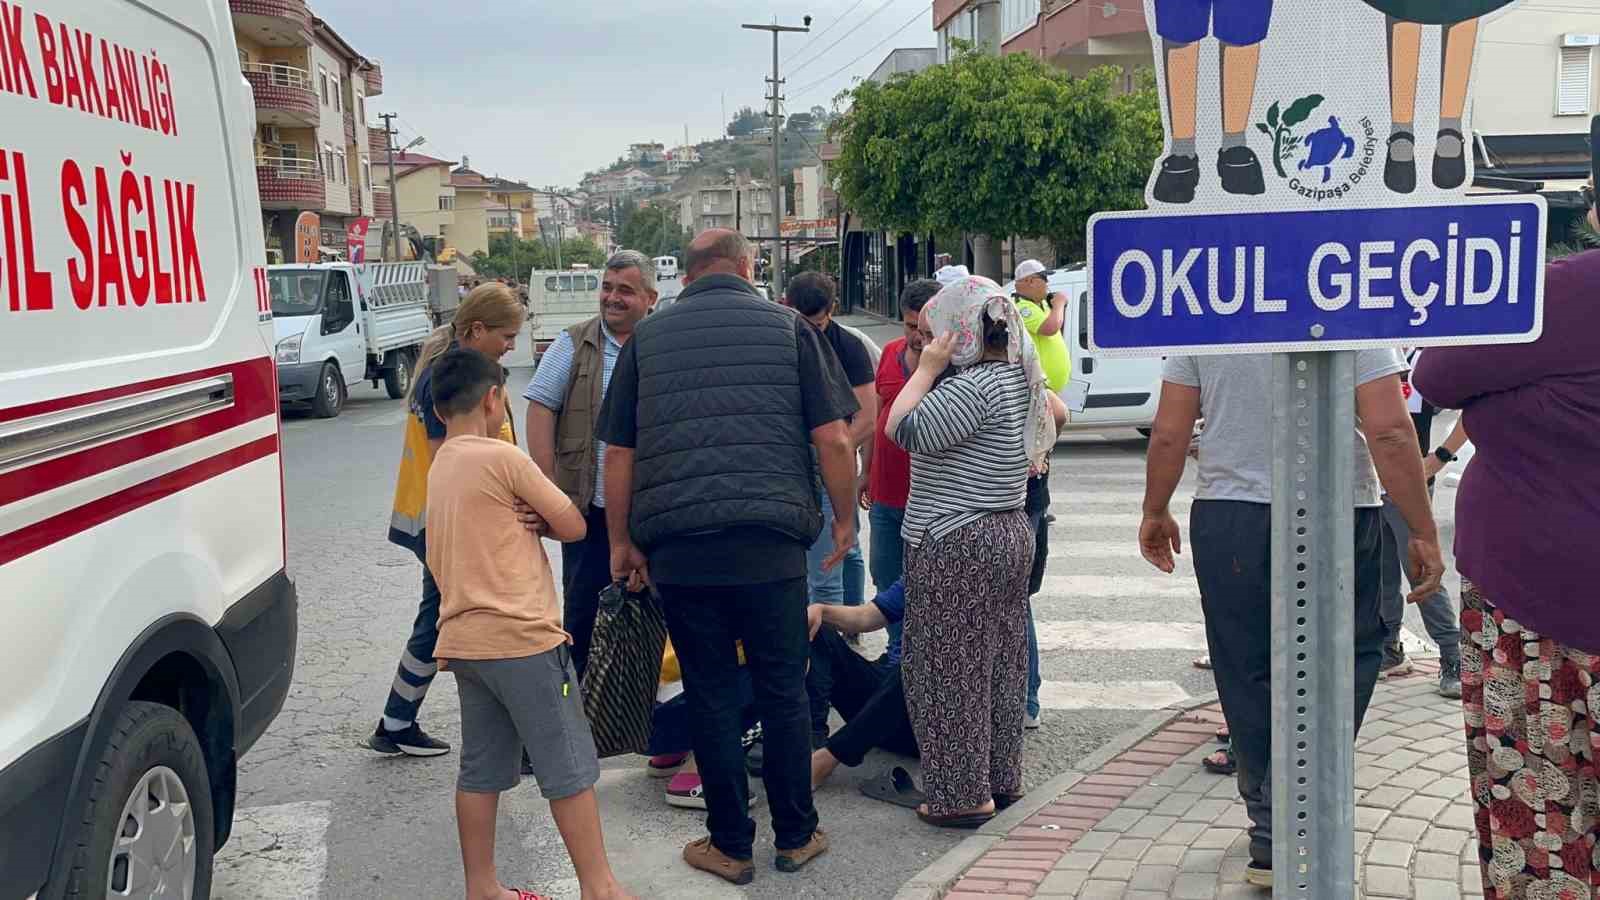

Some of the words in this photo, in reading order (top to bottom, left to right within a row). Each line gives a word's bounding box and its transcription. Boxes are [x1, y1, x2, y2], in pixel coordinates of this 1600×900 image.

[0, 0, 38, 98] IK
[35, 13, 177, 136] BAKANLIĞI
[1289, 178, 1350, 201] Gazipaşa
[1349, 116, 1377, 184] Belediyesi
[0, 148, 54, 312] İL
[61, 150, 206, 310] SAĞLIK
[1111, 246, 1287, 318] OKUL
[1307, 220, 1521, 326] GEÇİDİ
